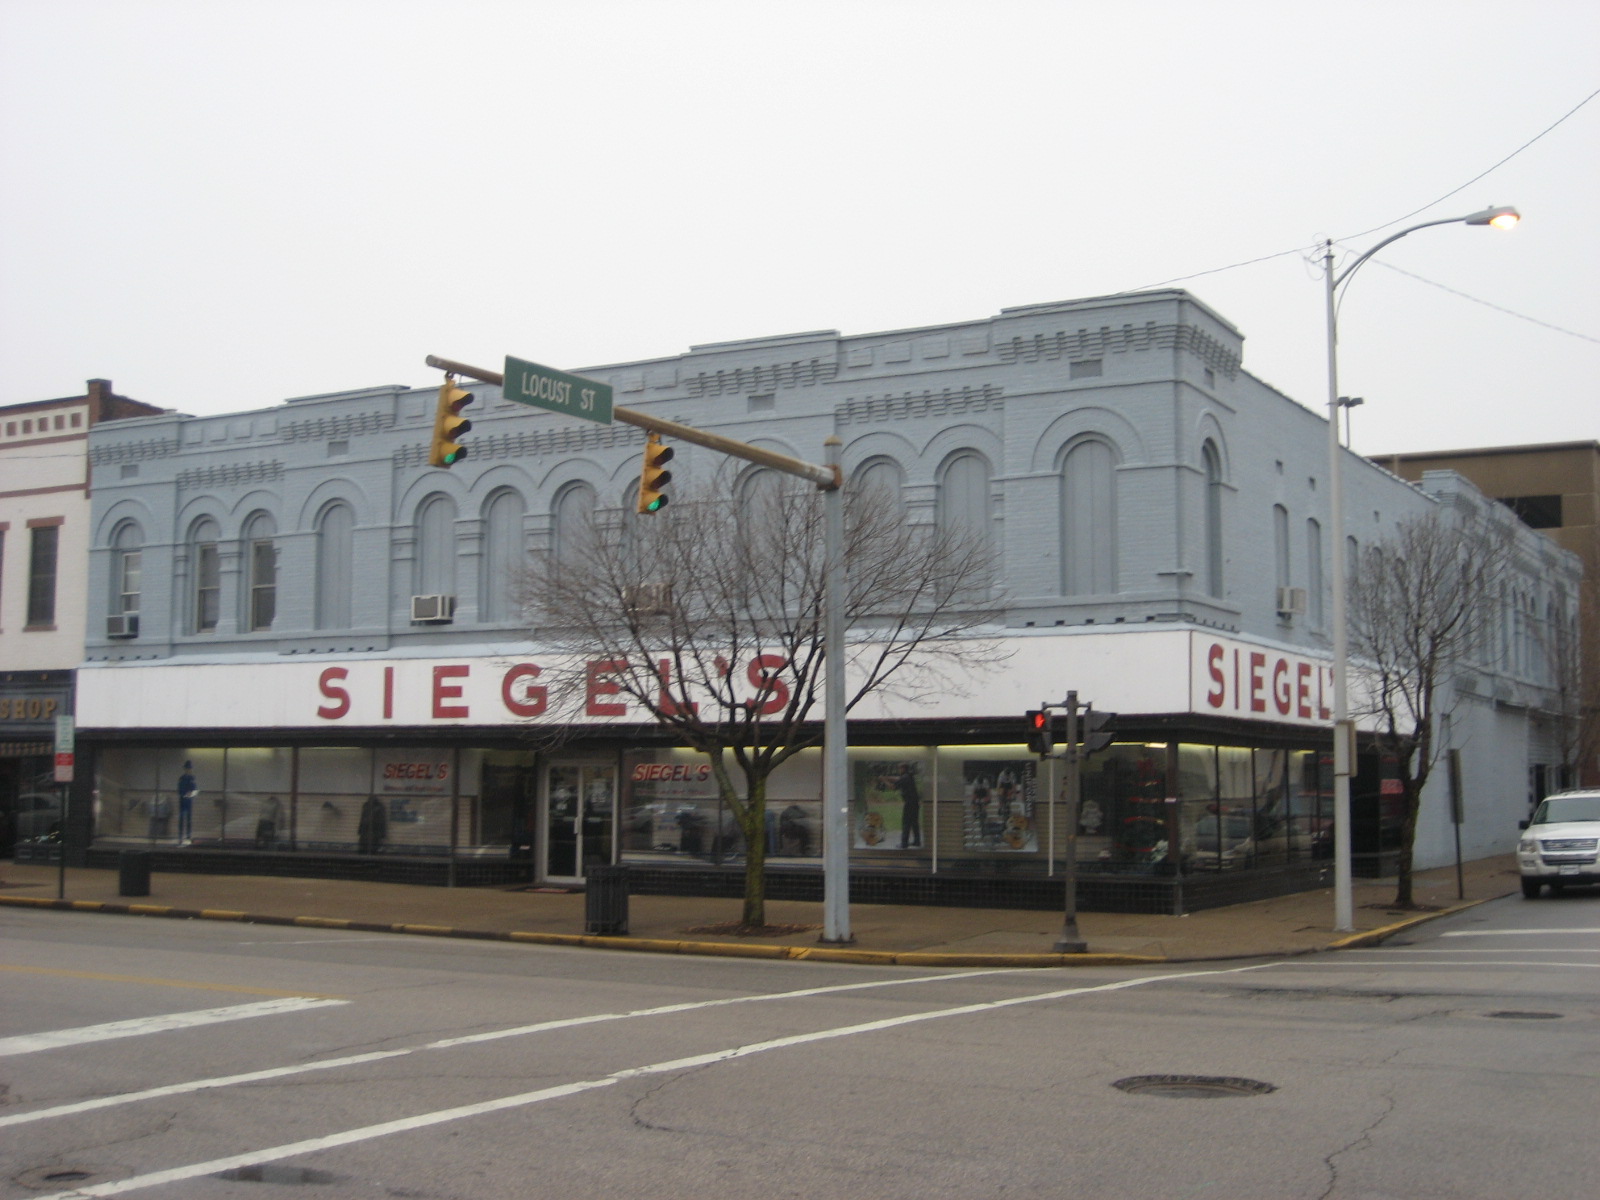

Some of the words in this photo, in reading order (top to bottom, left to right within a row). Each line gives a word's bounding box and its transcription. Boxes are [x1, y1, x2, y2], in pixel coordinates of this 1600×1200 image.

[521, 372, 572, 405] LOCUST
[581, 388, 596, 411] ST
[317, 653, 790, 720] SIEGEL'S
[1208, 643, 1334, 720] SIEGEL'
[0, 698, 57, 719] SHOP
[383, 762, 449, 780] SIEGEL'S
[631, 763, 712, 782] SIEGEL'S
